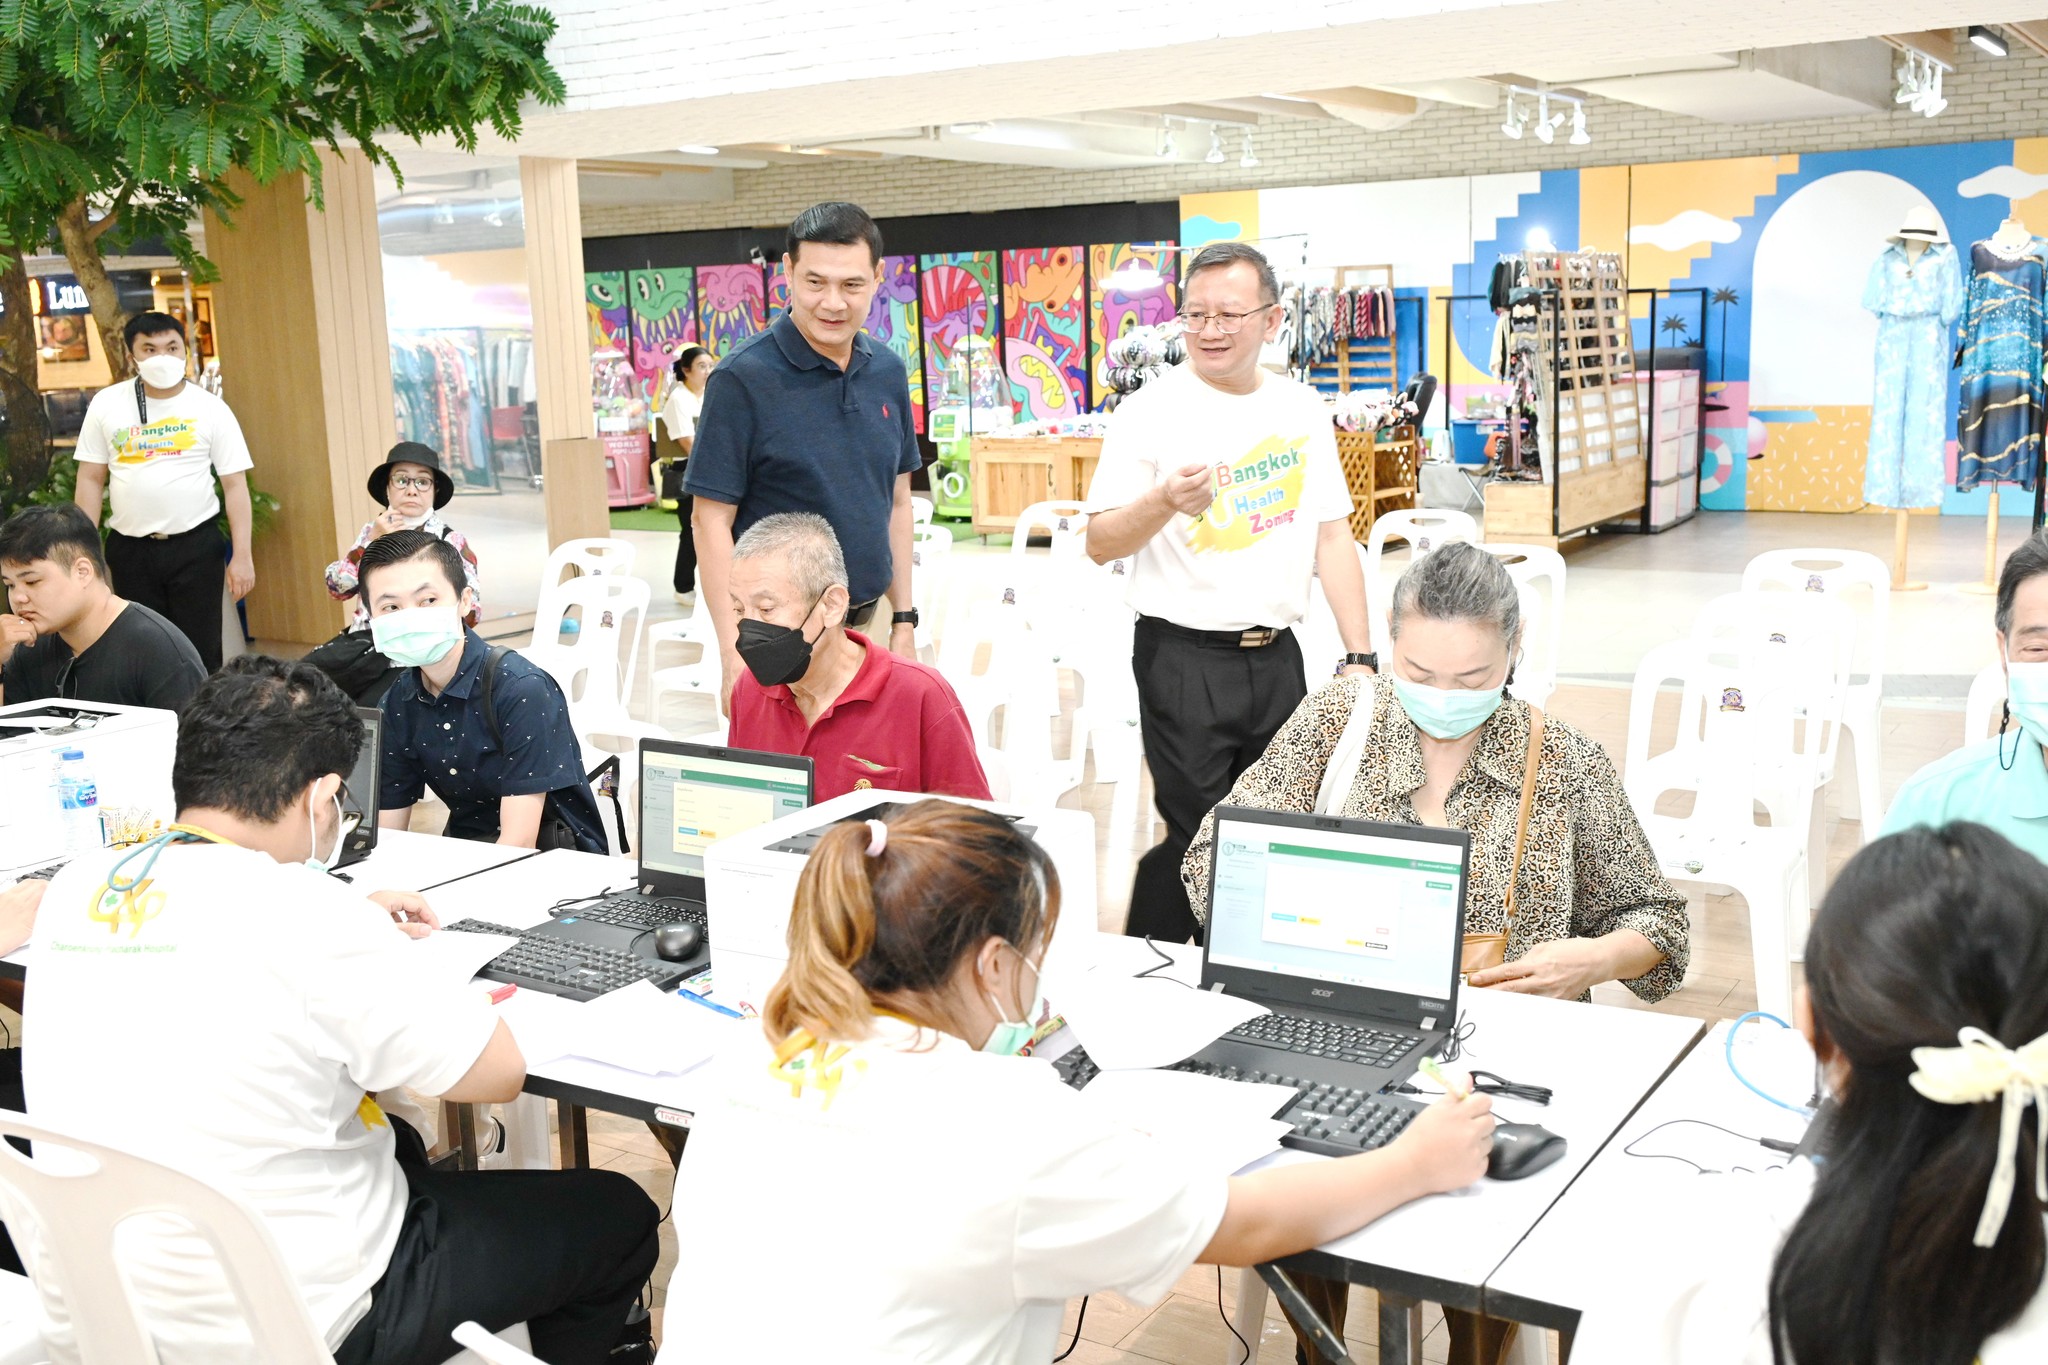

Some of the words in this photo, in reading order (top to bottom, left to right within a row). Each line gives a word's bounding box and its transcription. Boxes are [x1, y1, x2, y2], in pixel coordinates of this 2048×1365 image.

[130, 423, 188, 437] Bangkok
[1216, 447, 1299, 488] Bangkok
[1234, 487, 1284, 515] Health
[1249, 509, 1296, 534] Zoning
[1311, 988, 1335, 998] acer
